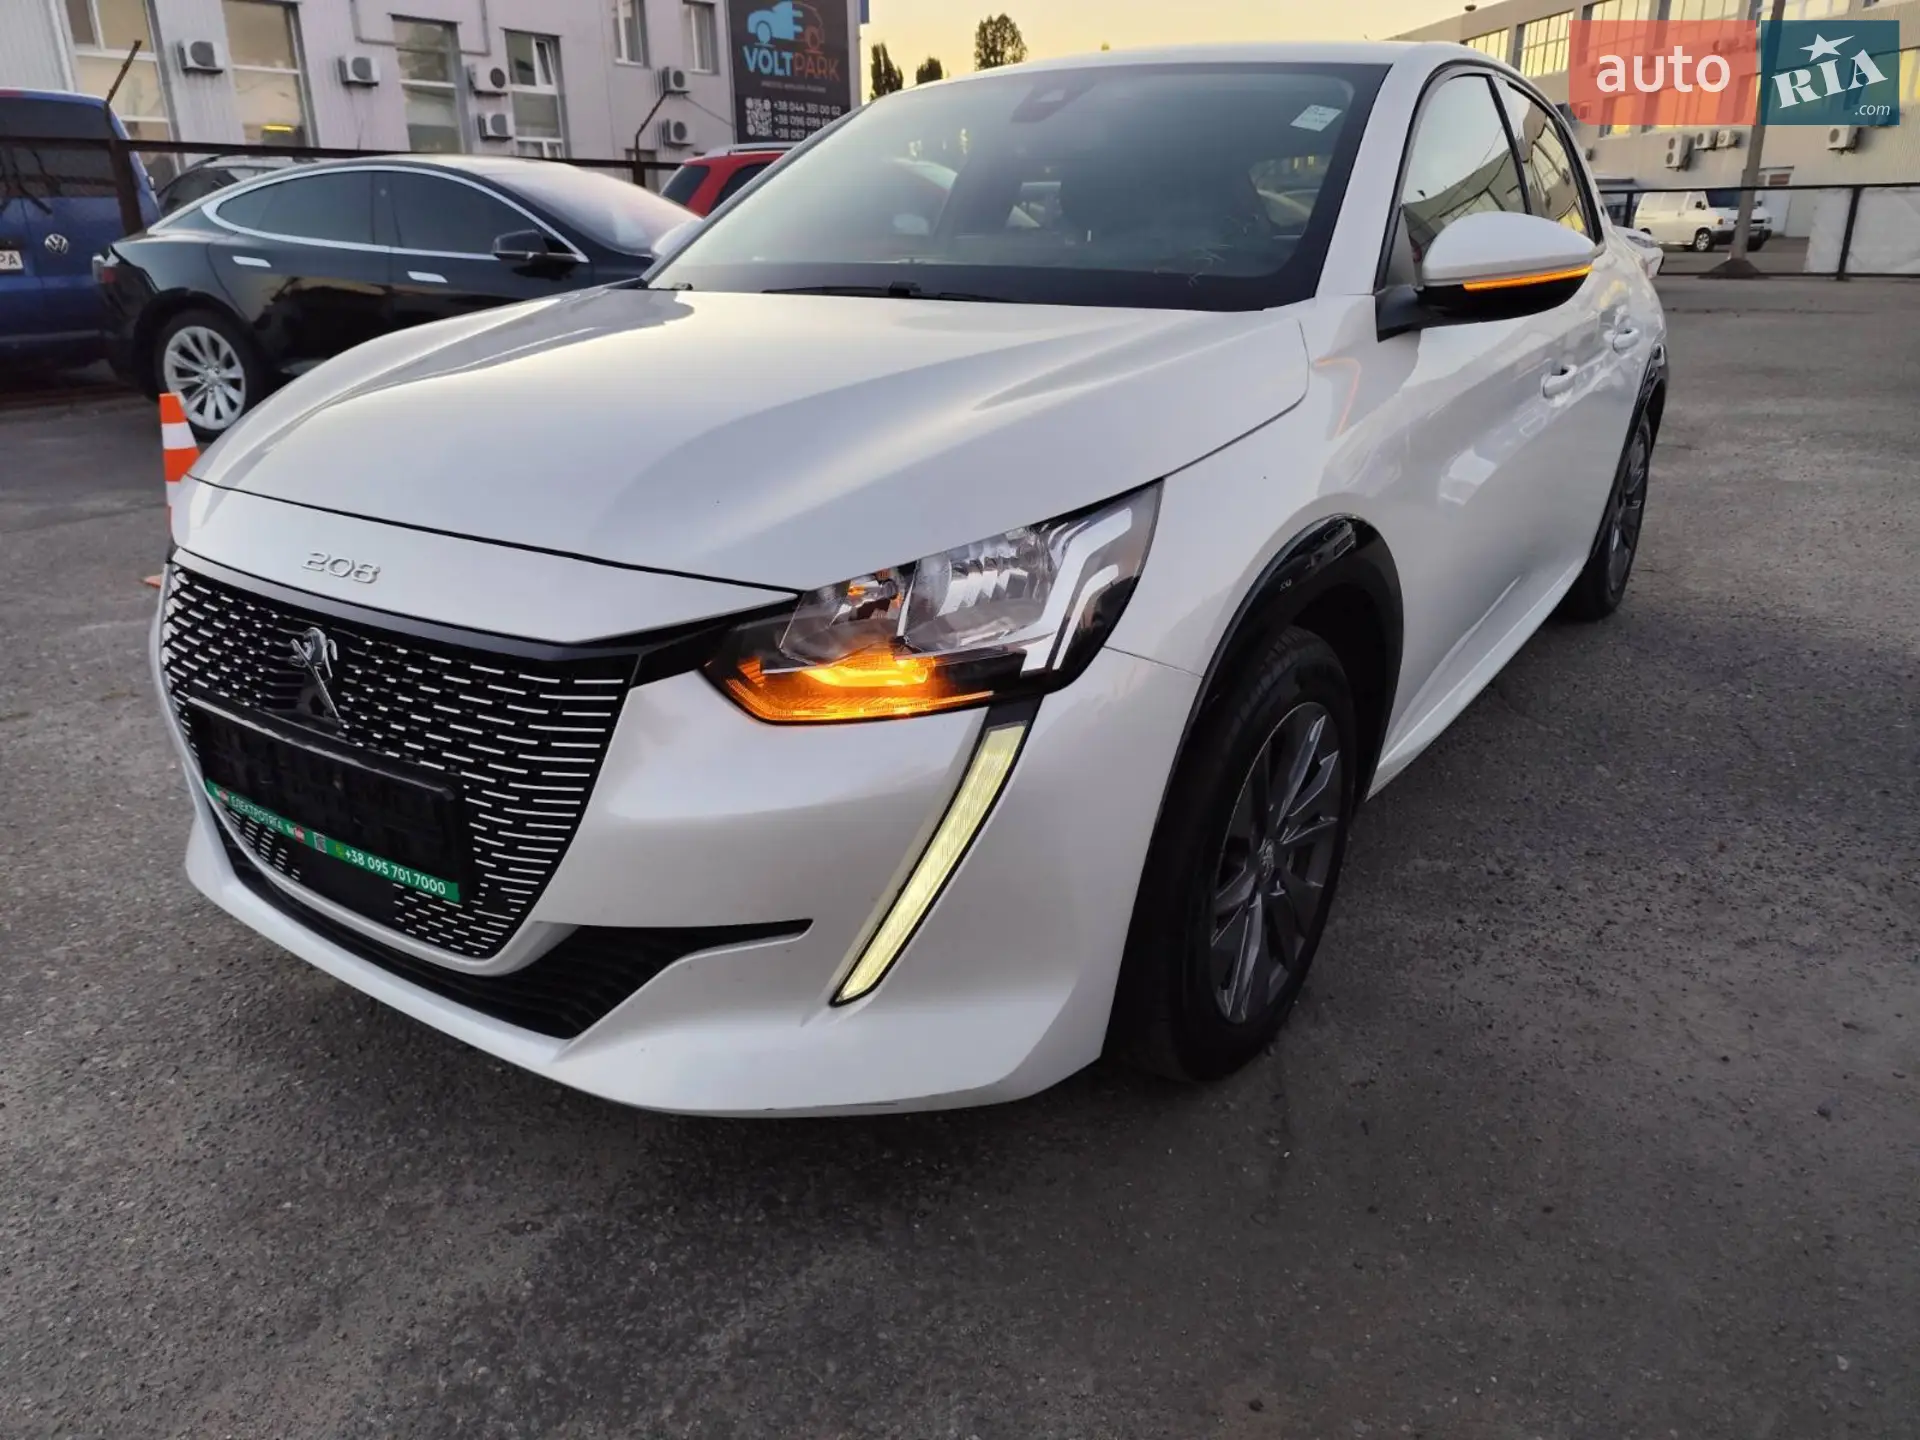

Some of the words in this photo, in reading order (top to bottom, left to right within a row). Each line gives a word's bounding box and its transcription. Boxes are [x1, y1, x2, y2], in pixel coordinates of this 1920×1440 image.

[301, 552, 381, 585] 208
[345, 849, 365, 866] +38
[367, 856, 389, 875] 095
[391, 865, 411, 884] 701
[413, 873, 446, 895] 7000
